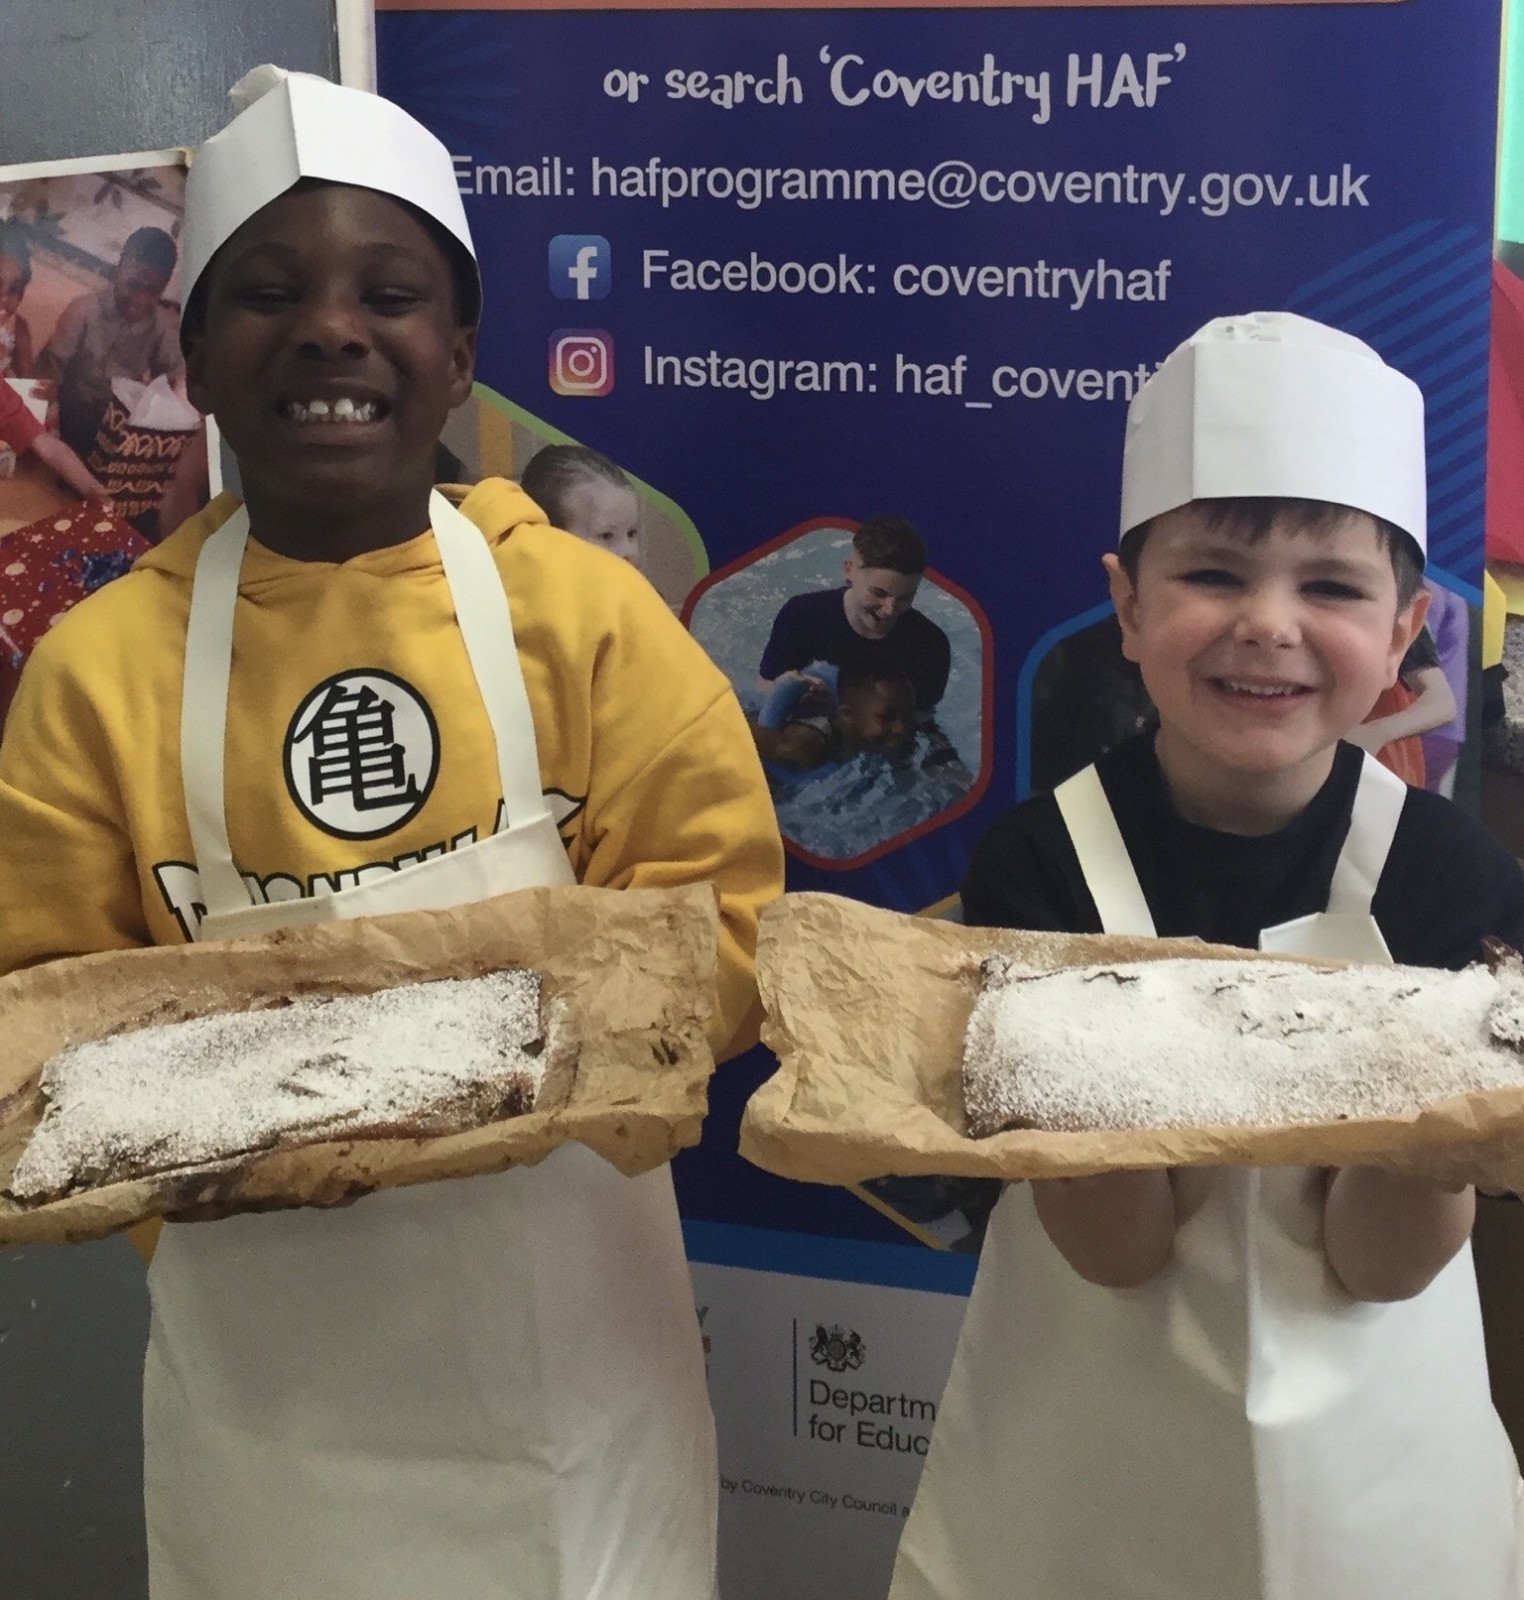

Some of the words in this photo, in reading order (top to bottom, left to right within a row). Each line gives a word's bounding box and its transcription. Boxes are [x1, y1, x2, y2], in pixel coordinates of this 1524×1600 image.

[603, 69, 650, 102] or
[665, 53, 803, 109] search
[450, 155, 575, 197] Email:
[592, 156, 1370, 217] hafprogramme@coventry.gov.uk
[642, 249, 877, 295] Facebook:
[893, 259, 1172, 311] coventryhaf
[644, 346, 877, 400] Instagram:
[895, 355, 1164, 409] haf_covent
[808, 1413, 847, 1443] for
[741, 1479, 805, 1504] Coventry
[809, 1490, 838, 1509] City
[841, 1494, 897, 1516] Council
